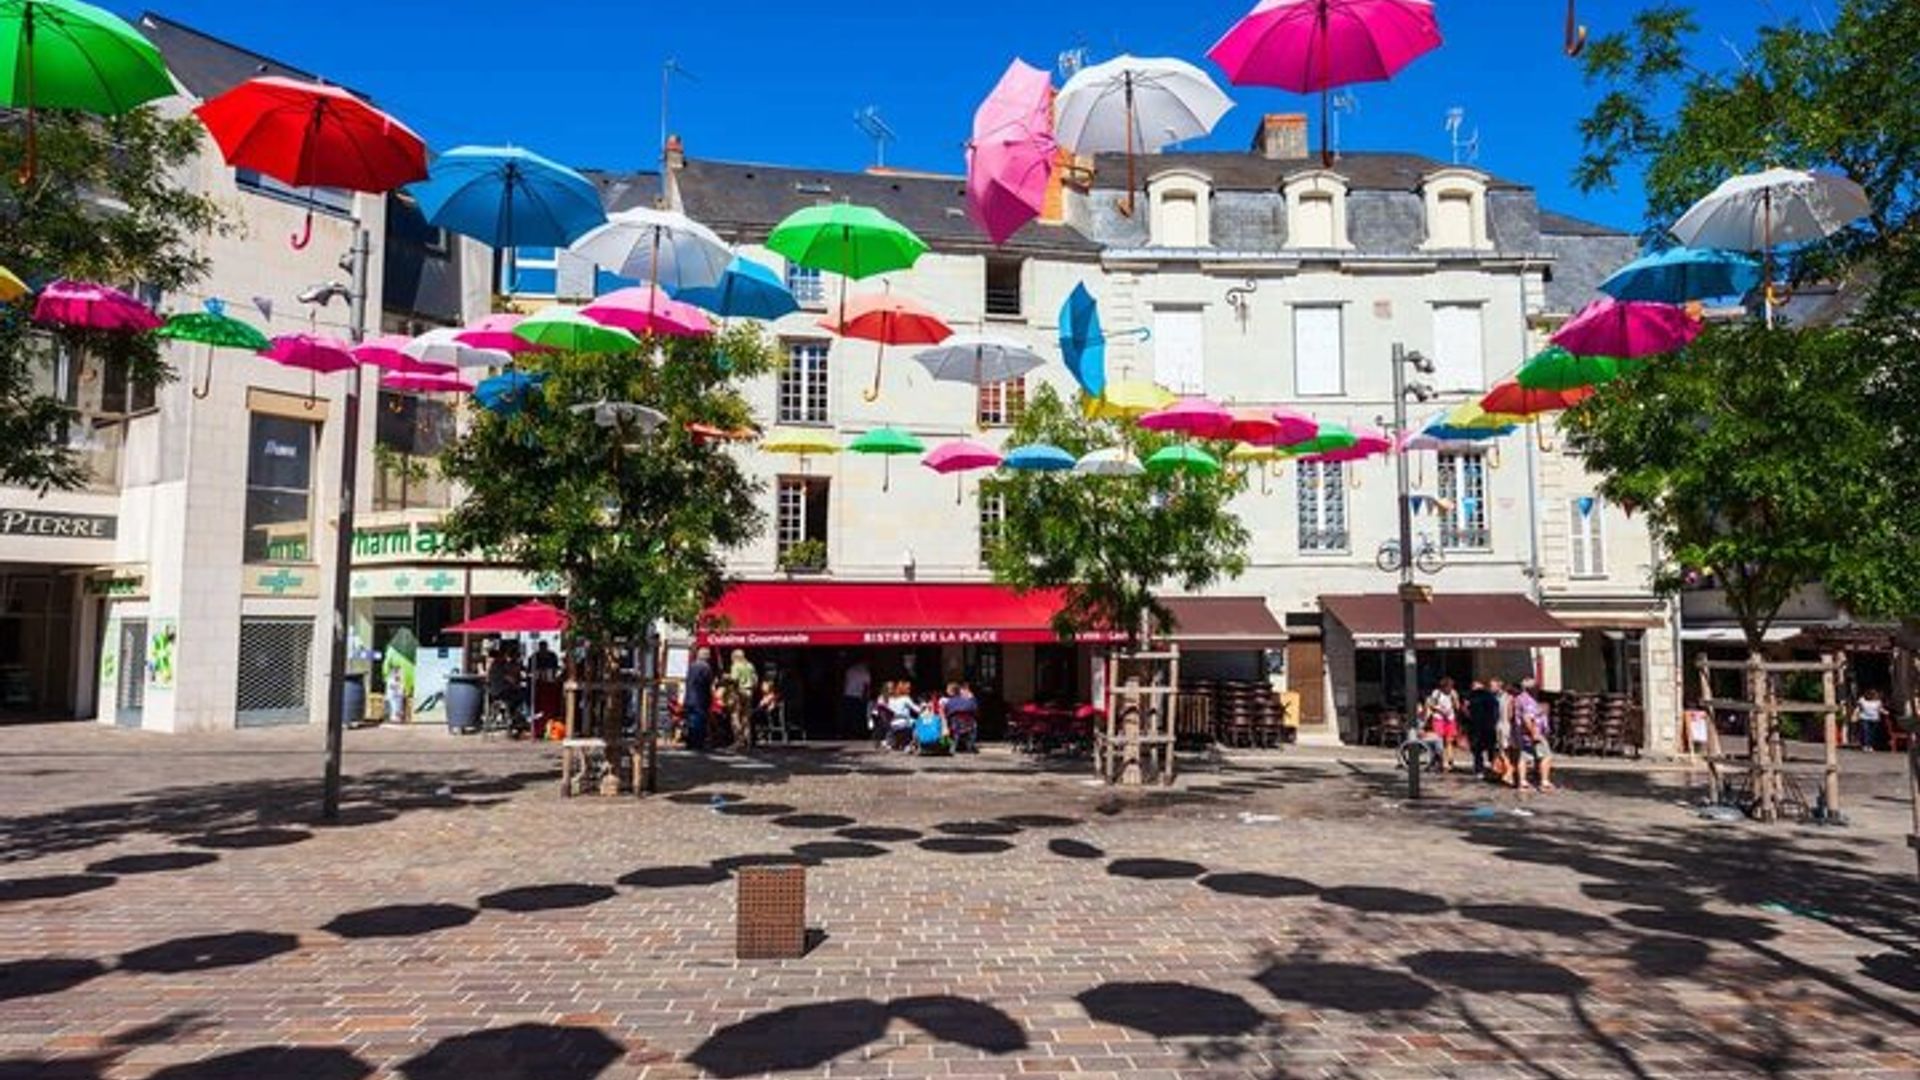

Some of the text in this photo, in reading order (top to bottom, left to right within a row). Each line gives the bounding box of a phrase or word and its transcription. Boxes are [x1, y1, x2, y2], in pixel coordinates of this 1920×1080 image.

[2, 510, 105, 537] PIERRE
[863, 630, 997, 643] BISTROT DE LA PLACE
